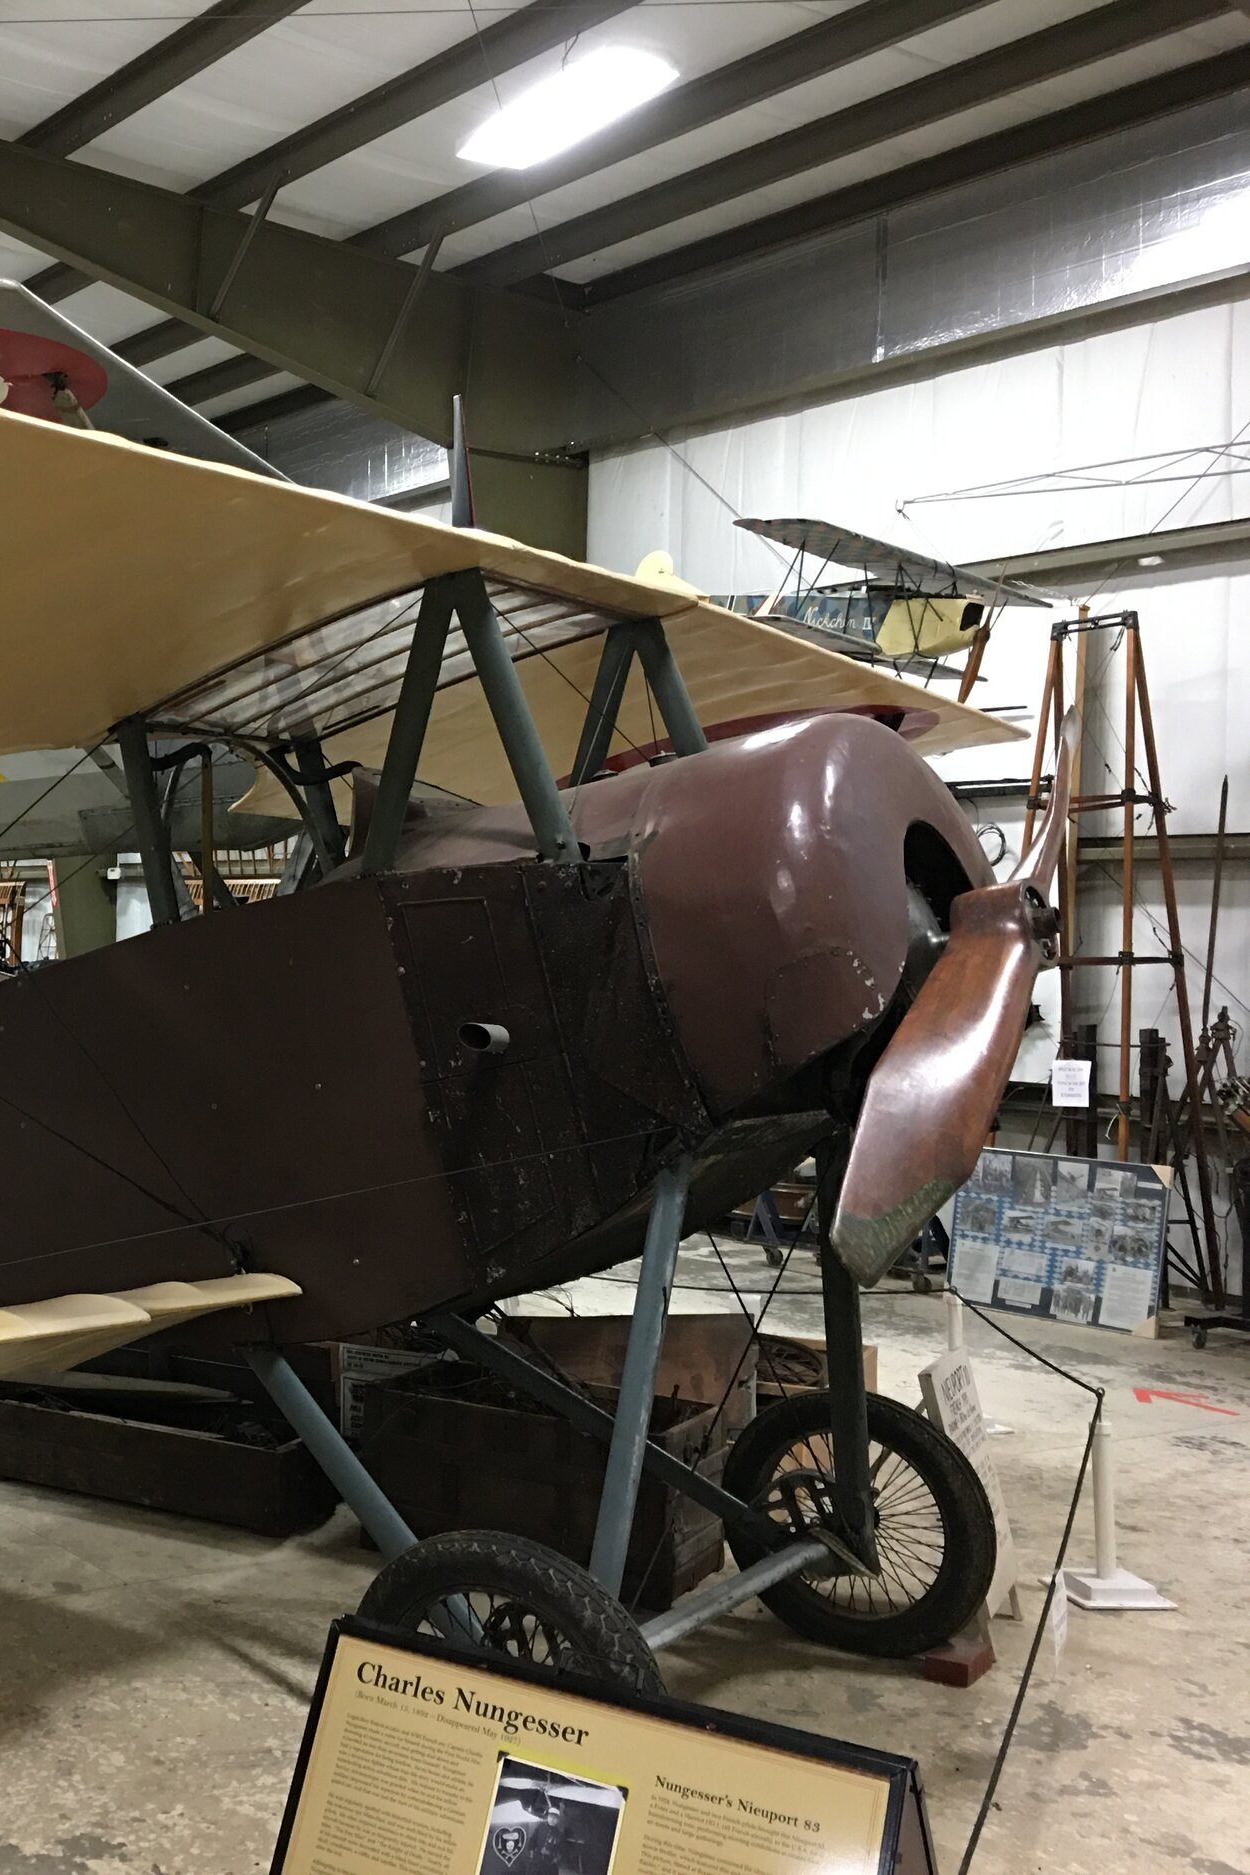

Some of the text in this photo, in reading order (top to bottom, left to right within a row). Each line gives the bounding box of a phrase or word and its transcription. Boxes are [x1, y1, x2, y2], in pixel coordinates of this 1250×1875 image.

[803, 606, 856, 629] Nickchn
[356, 1661, 590, 1746] Charles Nungesser
[654, 1775, 734, 1809] Nungesser's
[737, 1798, 799, 1828] Nieuport
[803, 1819, 821, 1834] 83
